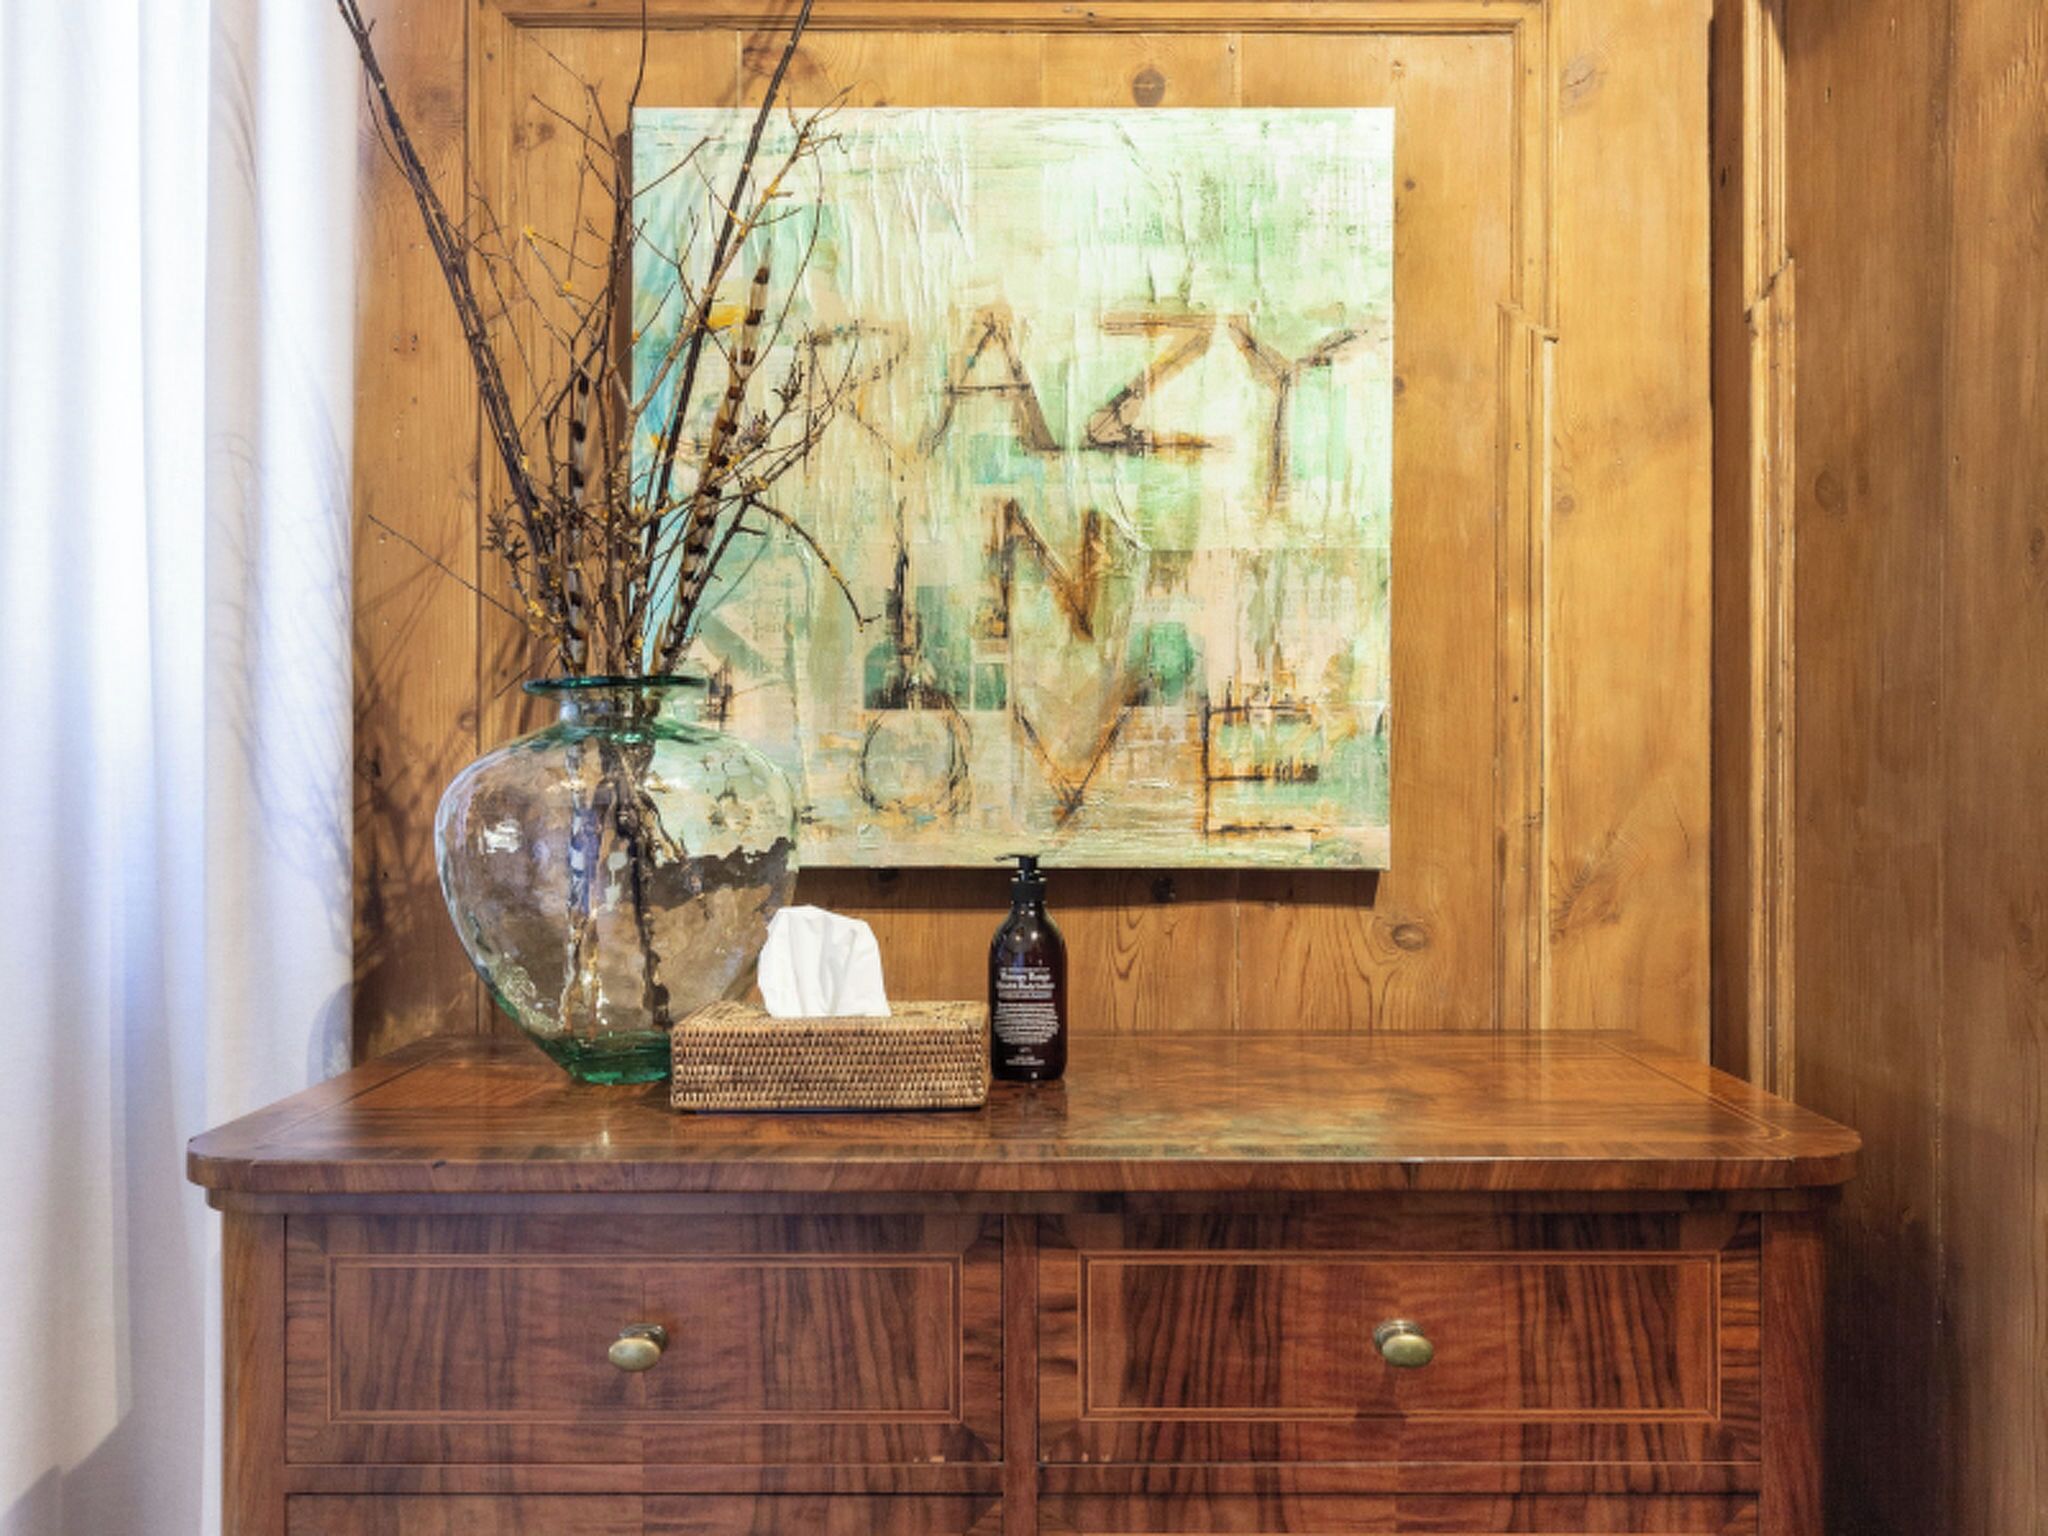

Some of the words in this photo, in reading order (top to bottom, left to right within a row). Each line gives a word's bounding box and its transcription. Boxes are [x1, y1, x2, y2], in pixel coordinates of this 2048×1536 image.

[800, 302, 1386, 514] RAZY
[882, 497, 1098, 668] IN
[803, 668, 1320, 838] OVE
